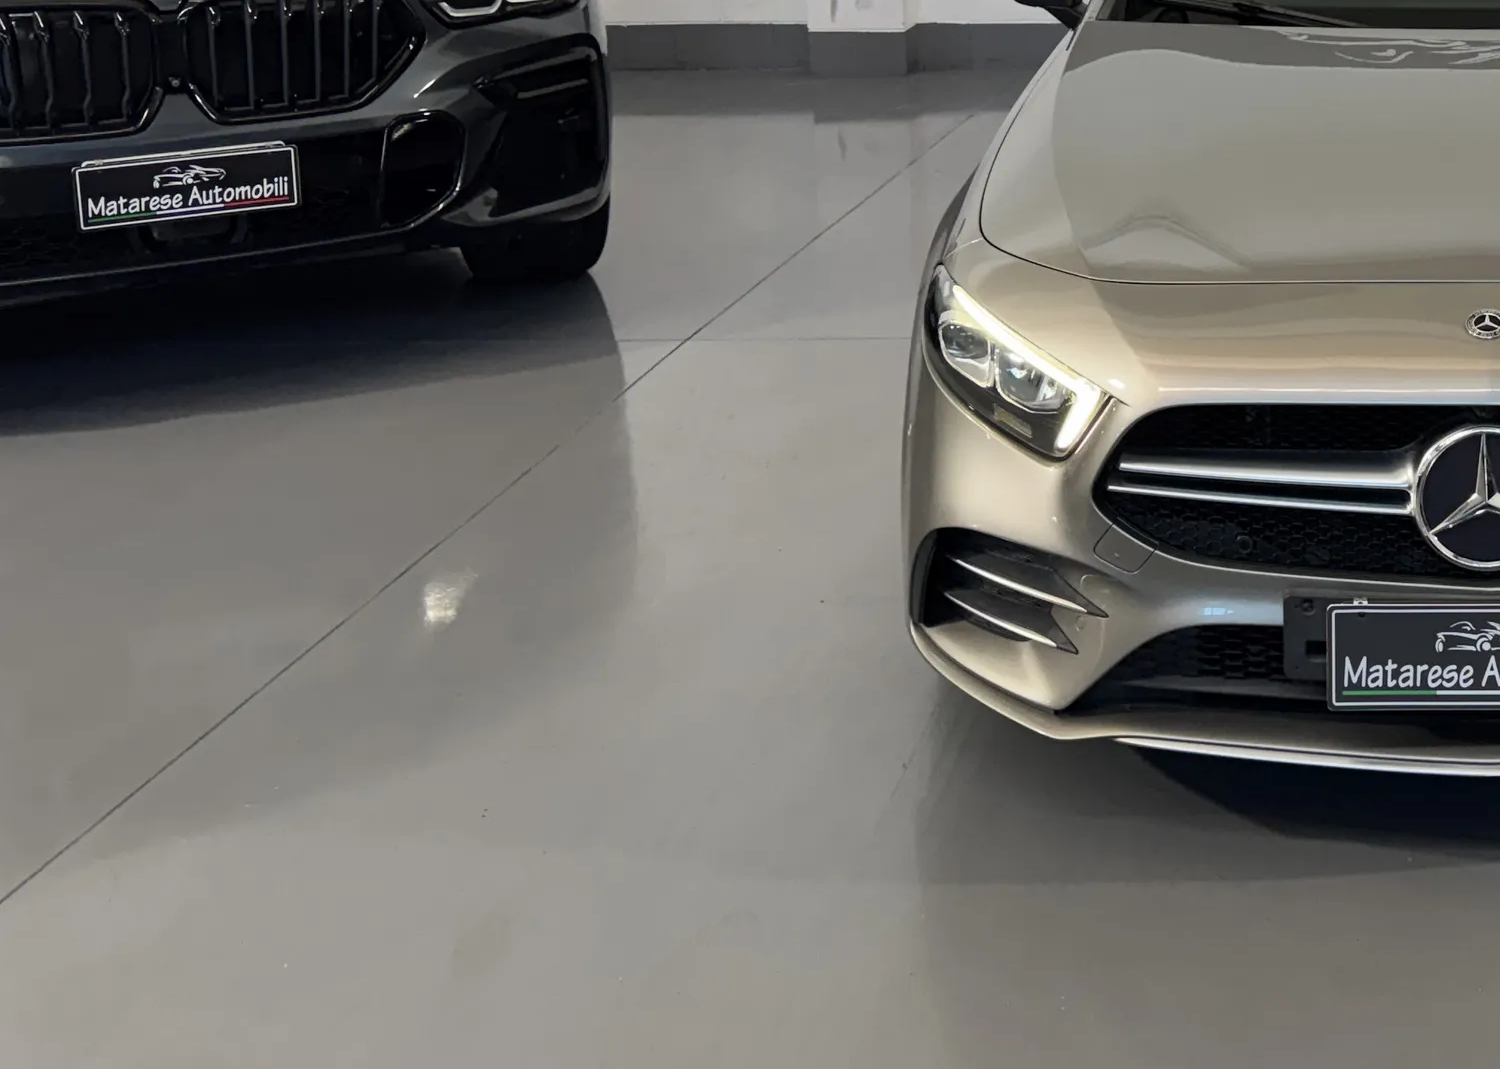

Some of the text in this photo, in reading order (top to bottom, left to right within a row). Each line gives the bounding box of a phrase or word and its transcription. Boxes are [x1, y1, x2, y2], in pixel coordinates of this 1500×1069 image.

[87, 175, 289, 218] Matarese Automobili
[1343, 655, 1474, 688] Matarese
